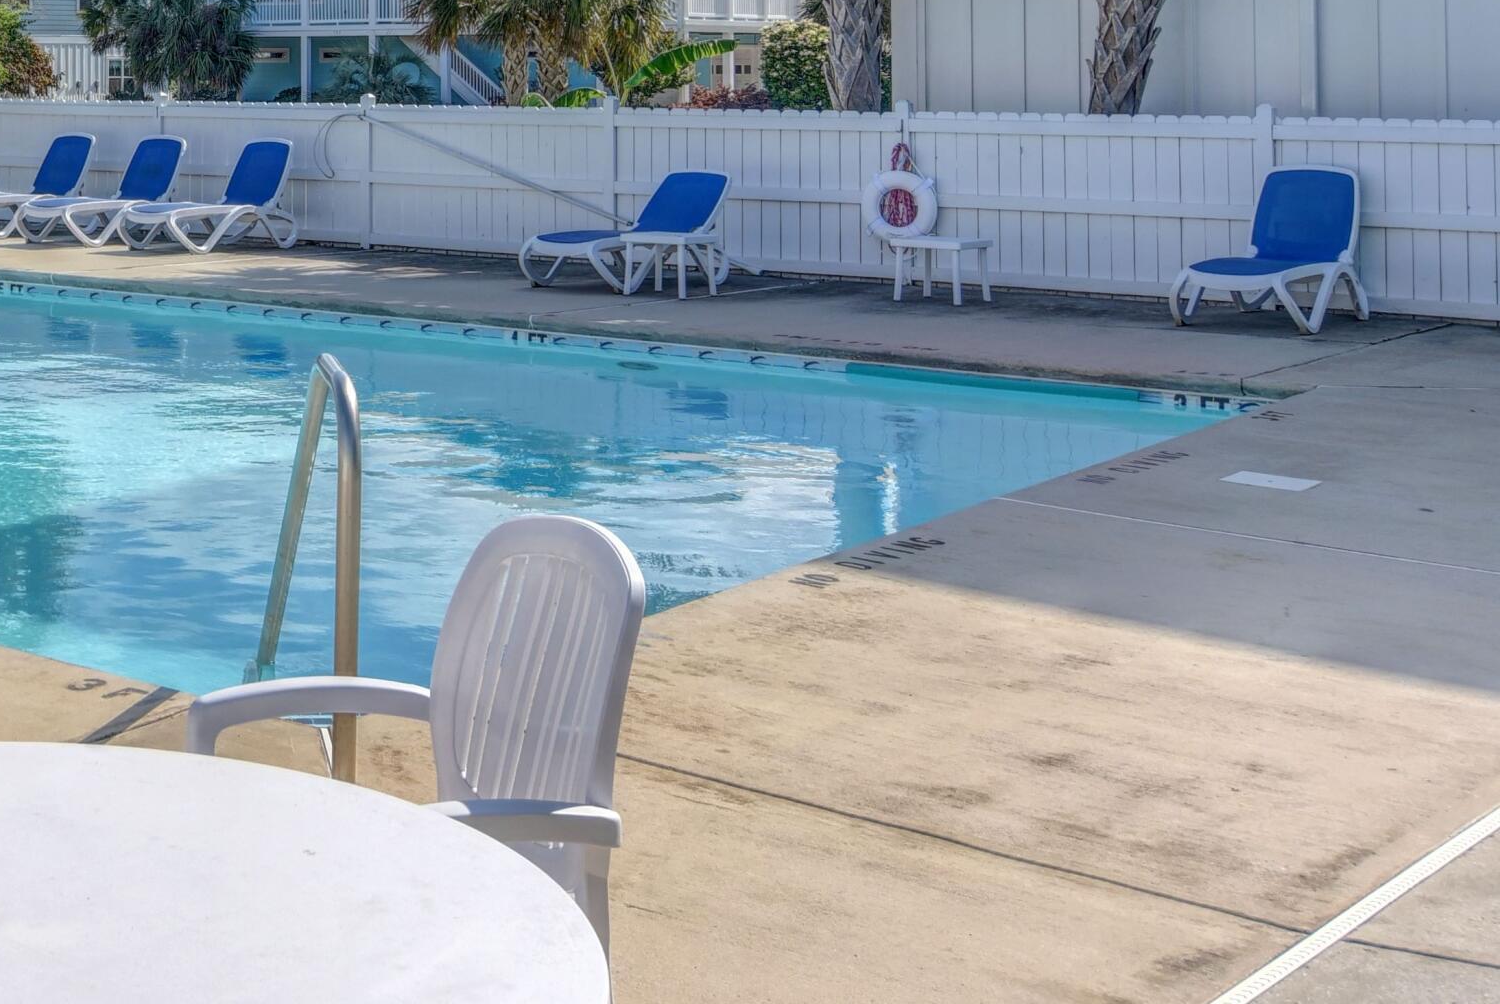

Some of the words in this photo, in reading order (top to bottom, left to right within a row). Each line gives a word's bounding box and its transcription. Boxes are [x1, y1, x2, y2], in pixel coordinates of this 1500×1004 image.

[787, 573, 841, 590] NO
[833, 536, 947, 571] DIVING
[66, 678, 108, 691] 3
